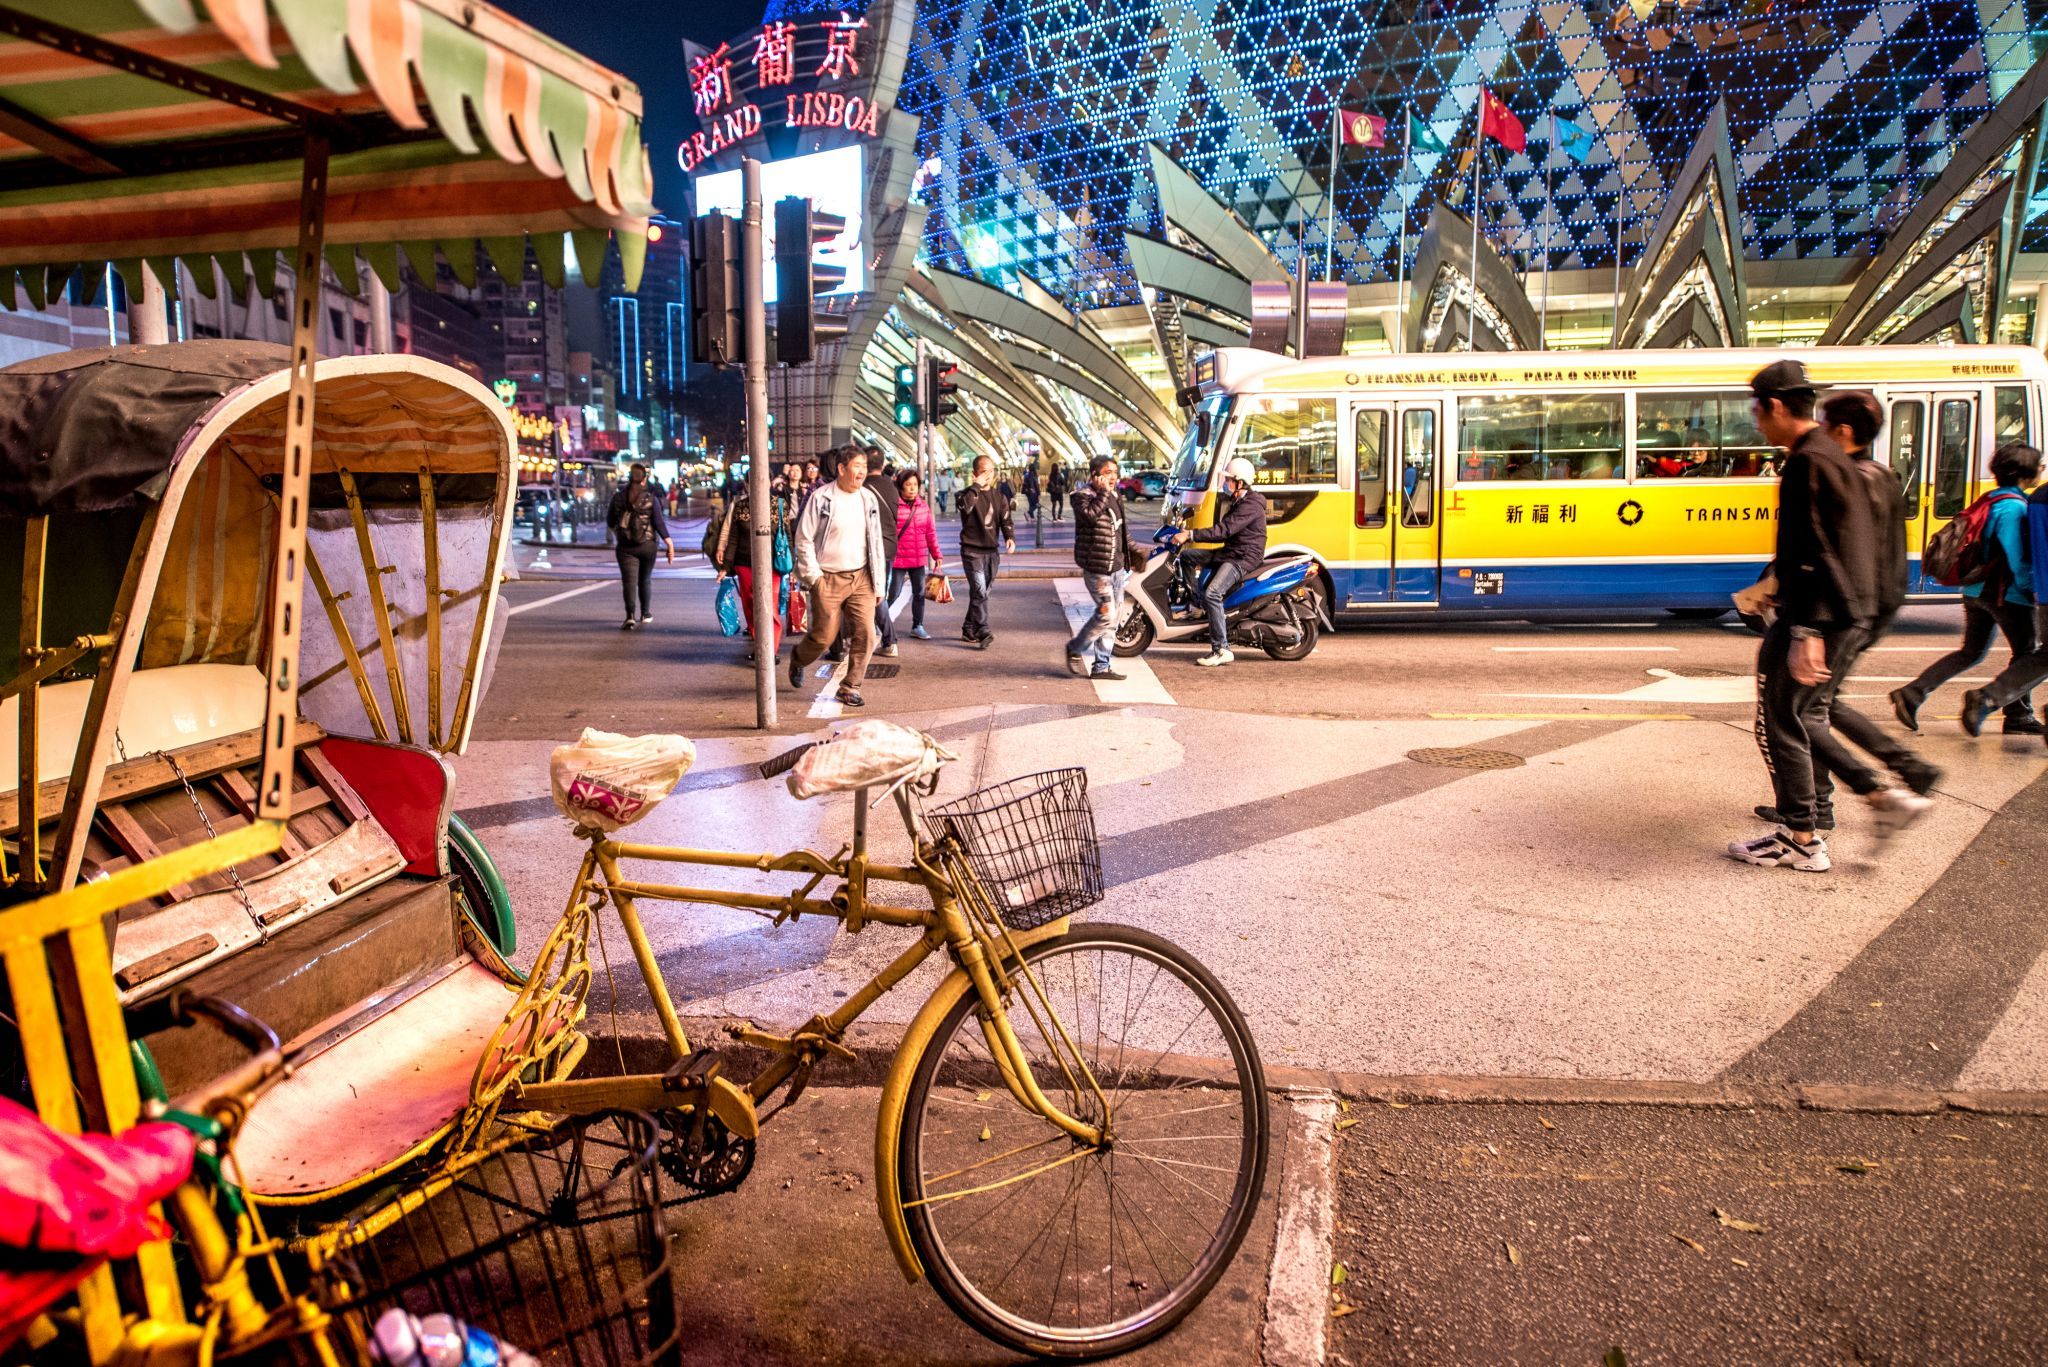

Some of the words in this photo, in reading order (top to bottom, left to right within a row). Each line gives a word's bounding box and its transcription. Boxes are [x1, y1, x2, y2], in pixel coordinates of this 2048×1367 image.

[690, 10, 868, 116] 新葡京
[677, 103, 762, 172] GRAND
[785, 91, 878, 137] LISBOA
[1523, 370, 1564, 381] PARA
[1583, 369, 1637, 380] SERVIR
[1446, 491, 1466, 511] 上
[1506, 504, 1577, 524] 新福利
